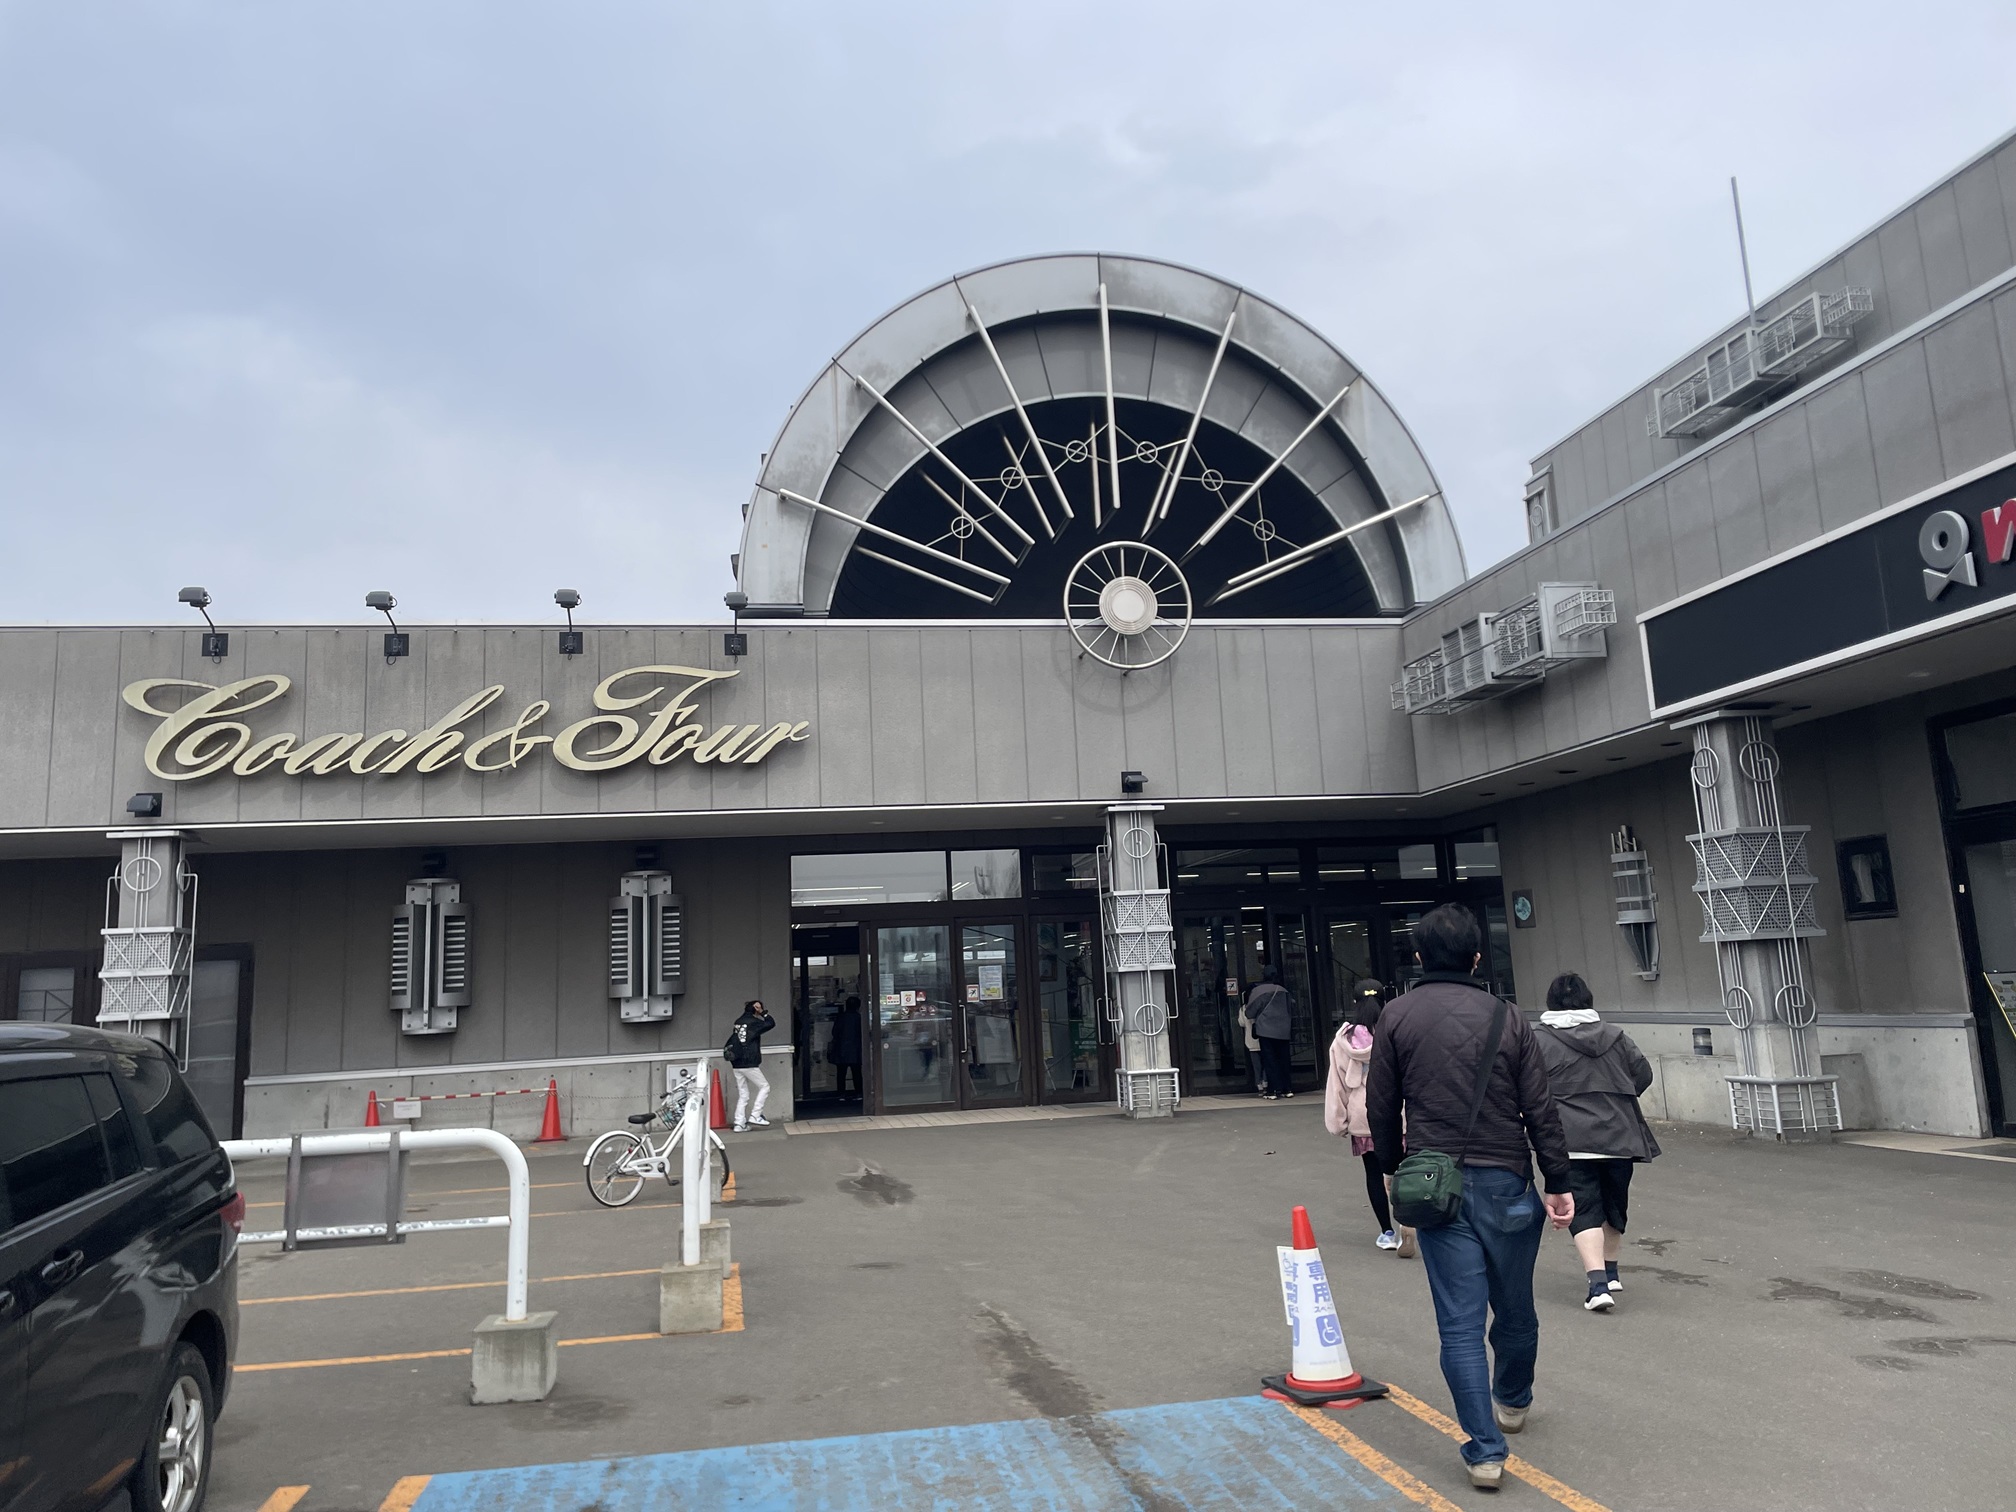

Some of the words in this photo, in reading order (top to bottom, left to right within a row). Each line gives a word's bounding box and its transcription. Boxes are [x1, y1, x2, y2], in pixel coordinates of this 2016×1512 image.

[122, 674, 505, 781] Coach
[464, 699, 553, 772] &
[553, 664, 811, 771] Four
